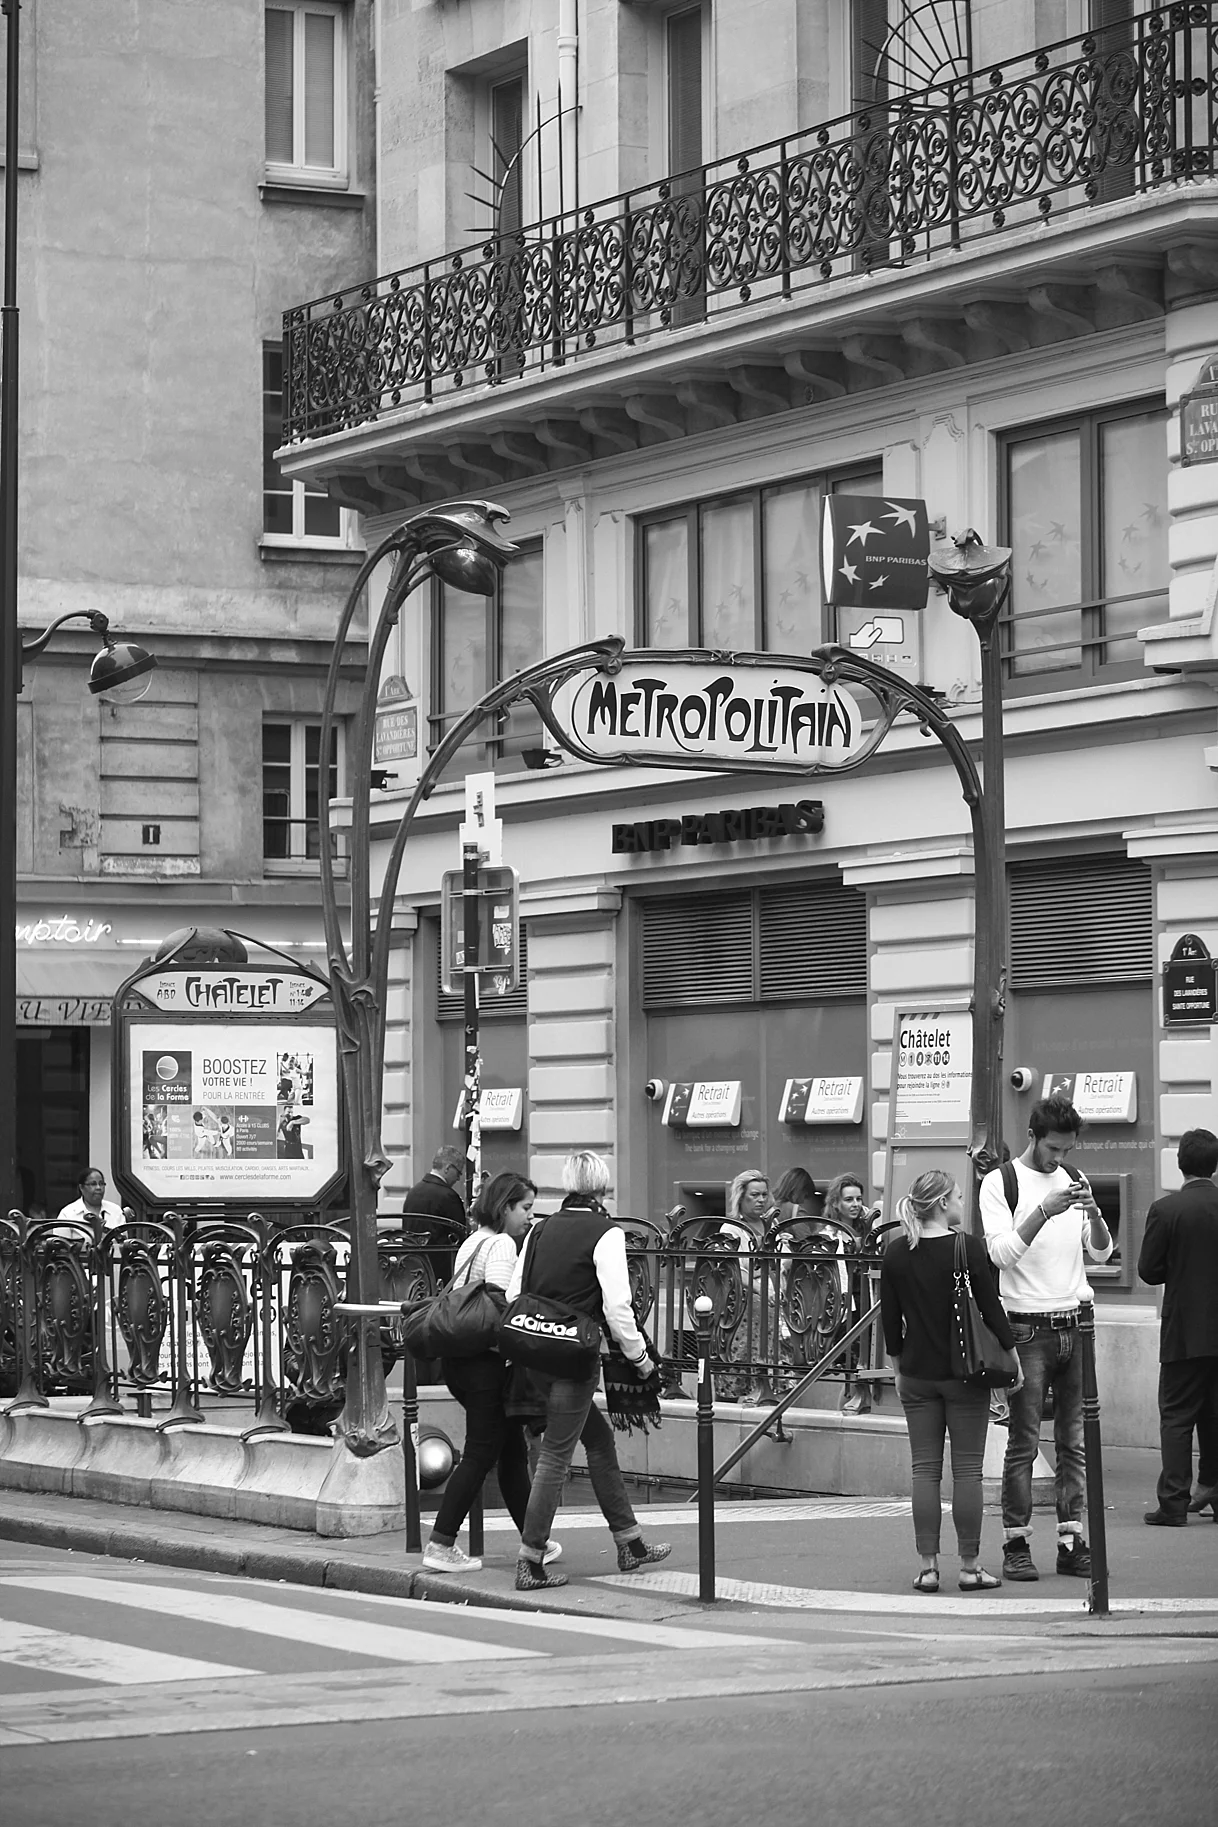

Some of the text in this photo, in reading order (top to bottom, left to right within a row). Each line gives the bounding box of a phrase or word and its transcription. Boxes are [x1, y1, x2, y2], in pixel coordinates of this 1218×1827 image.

[865, 555, 927, 566] BNP PARIBAS
[383, 715, 409, 728] RUE DES
[586, 675, 852, 755] METROPOLITAIN
[383, 741, 415, 755] OPPORTUNE
[611, 799, 825, 854] BNP PARIBAS
[20, 1001, 42, 1020] U
[1186, 1001, 1210, 1010] OPPORTUNE
[900, 1029, 951, 1049] Châtelet
[203, 1058, 268, 1075] BOOSTEZ
[147, 1084, 188, 1093] Les Cercles
[202, 1077, 231, 1087] VOTRE
[234, 1077, 248, 1087] VIE
[817, 1078, 854, 1097] Retrait
[1083, 1073, 1125, 1094] Retrait
[145, 1093, 189, 1101] de la Forme
[203, 1090, 266, 1100] POUR LA RENTRÉE
[485, 1090, 513, 1106] Retrait
[697, 1082, 731, 1101] Retrait
[219, 1173, 292, 1181] www.cerclesdelaforme.com
